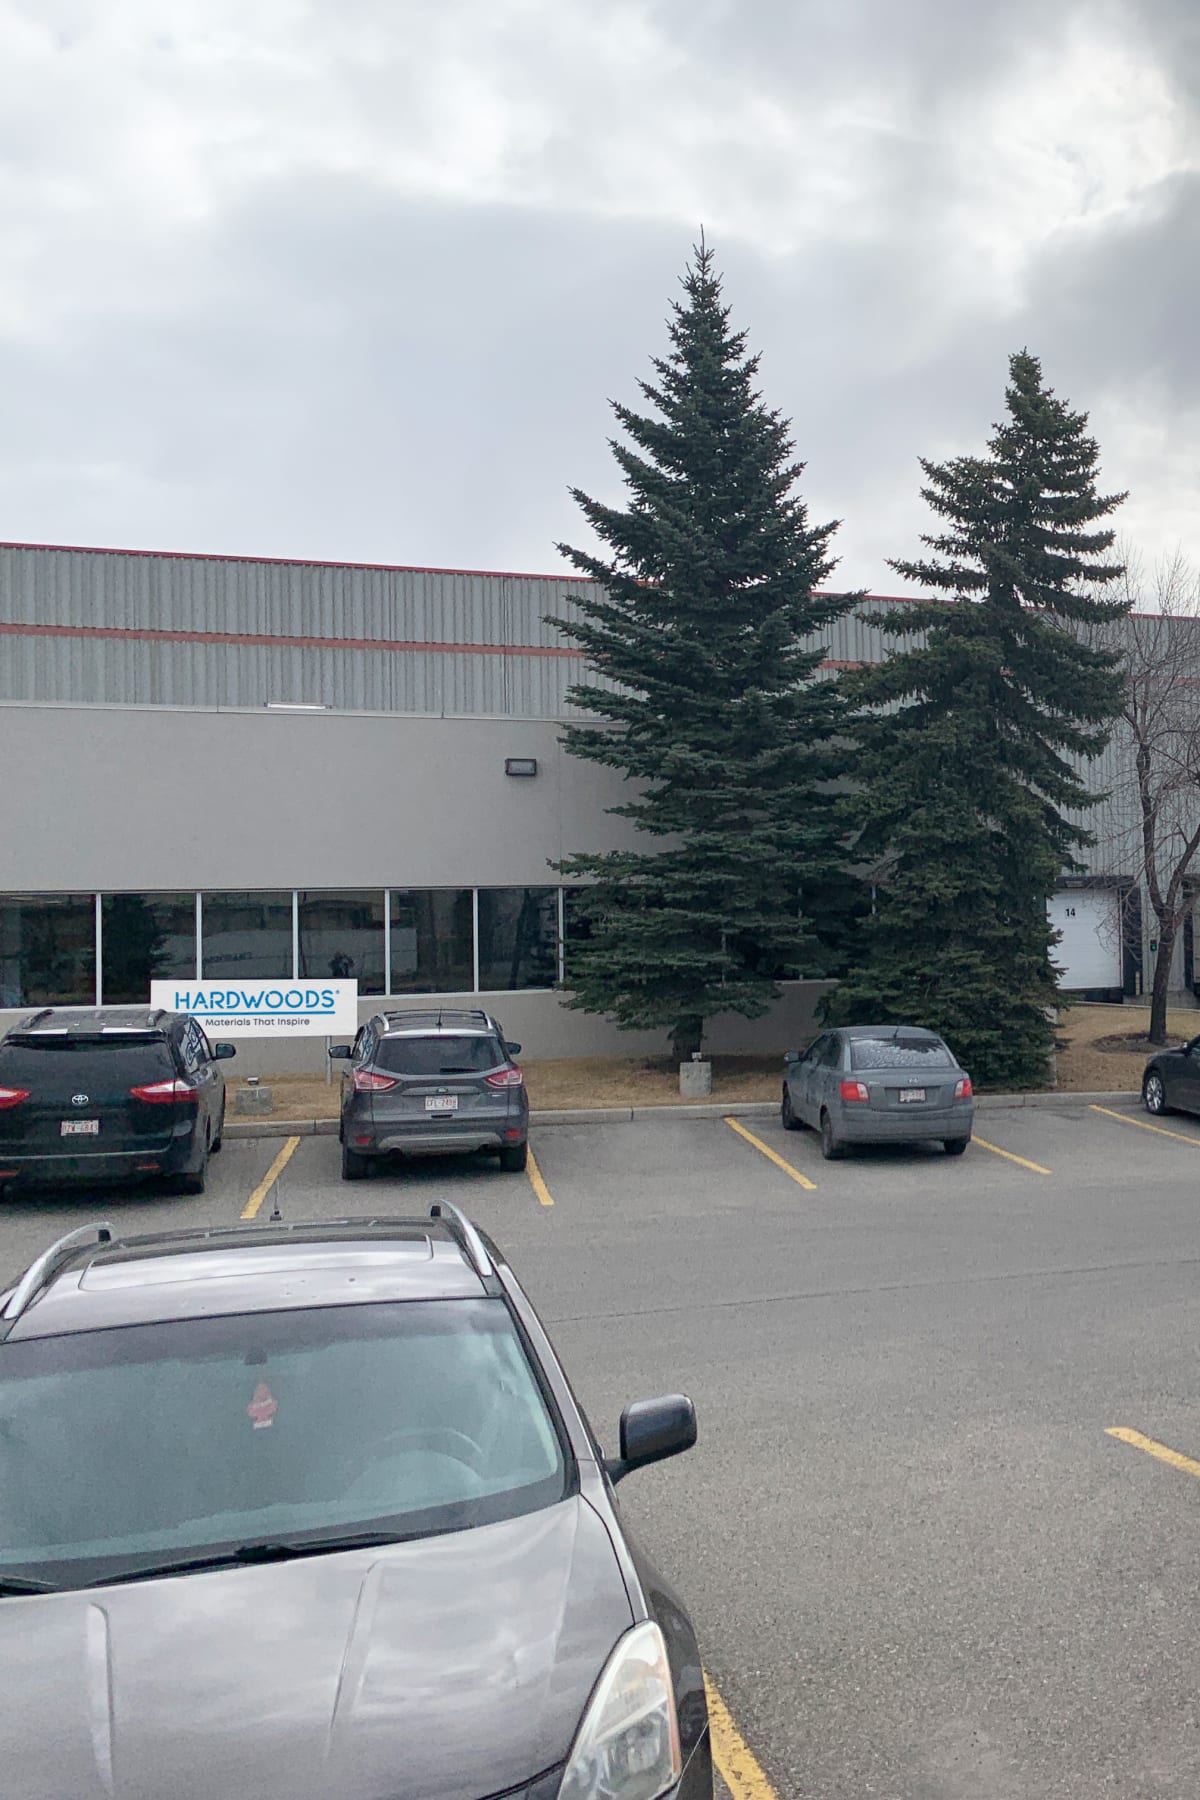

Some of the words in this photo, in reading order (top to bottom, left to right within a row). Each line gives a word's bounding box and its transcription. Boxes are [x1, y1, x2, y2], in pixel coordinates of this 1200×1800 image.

[1065, 908, 1076, 917] 14
[175, 989, 335, 1010] HARDWOODS
[205, 1018, 250, 1027] Materials
[253, 1018, 275, 1026] That
[277, 1018, 310, 1027] Inspire
